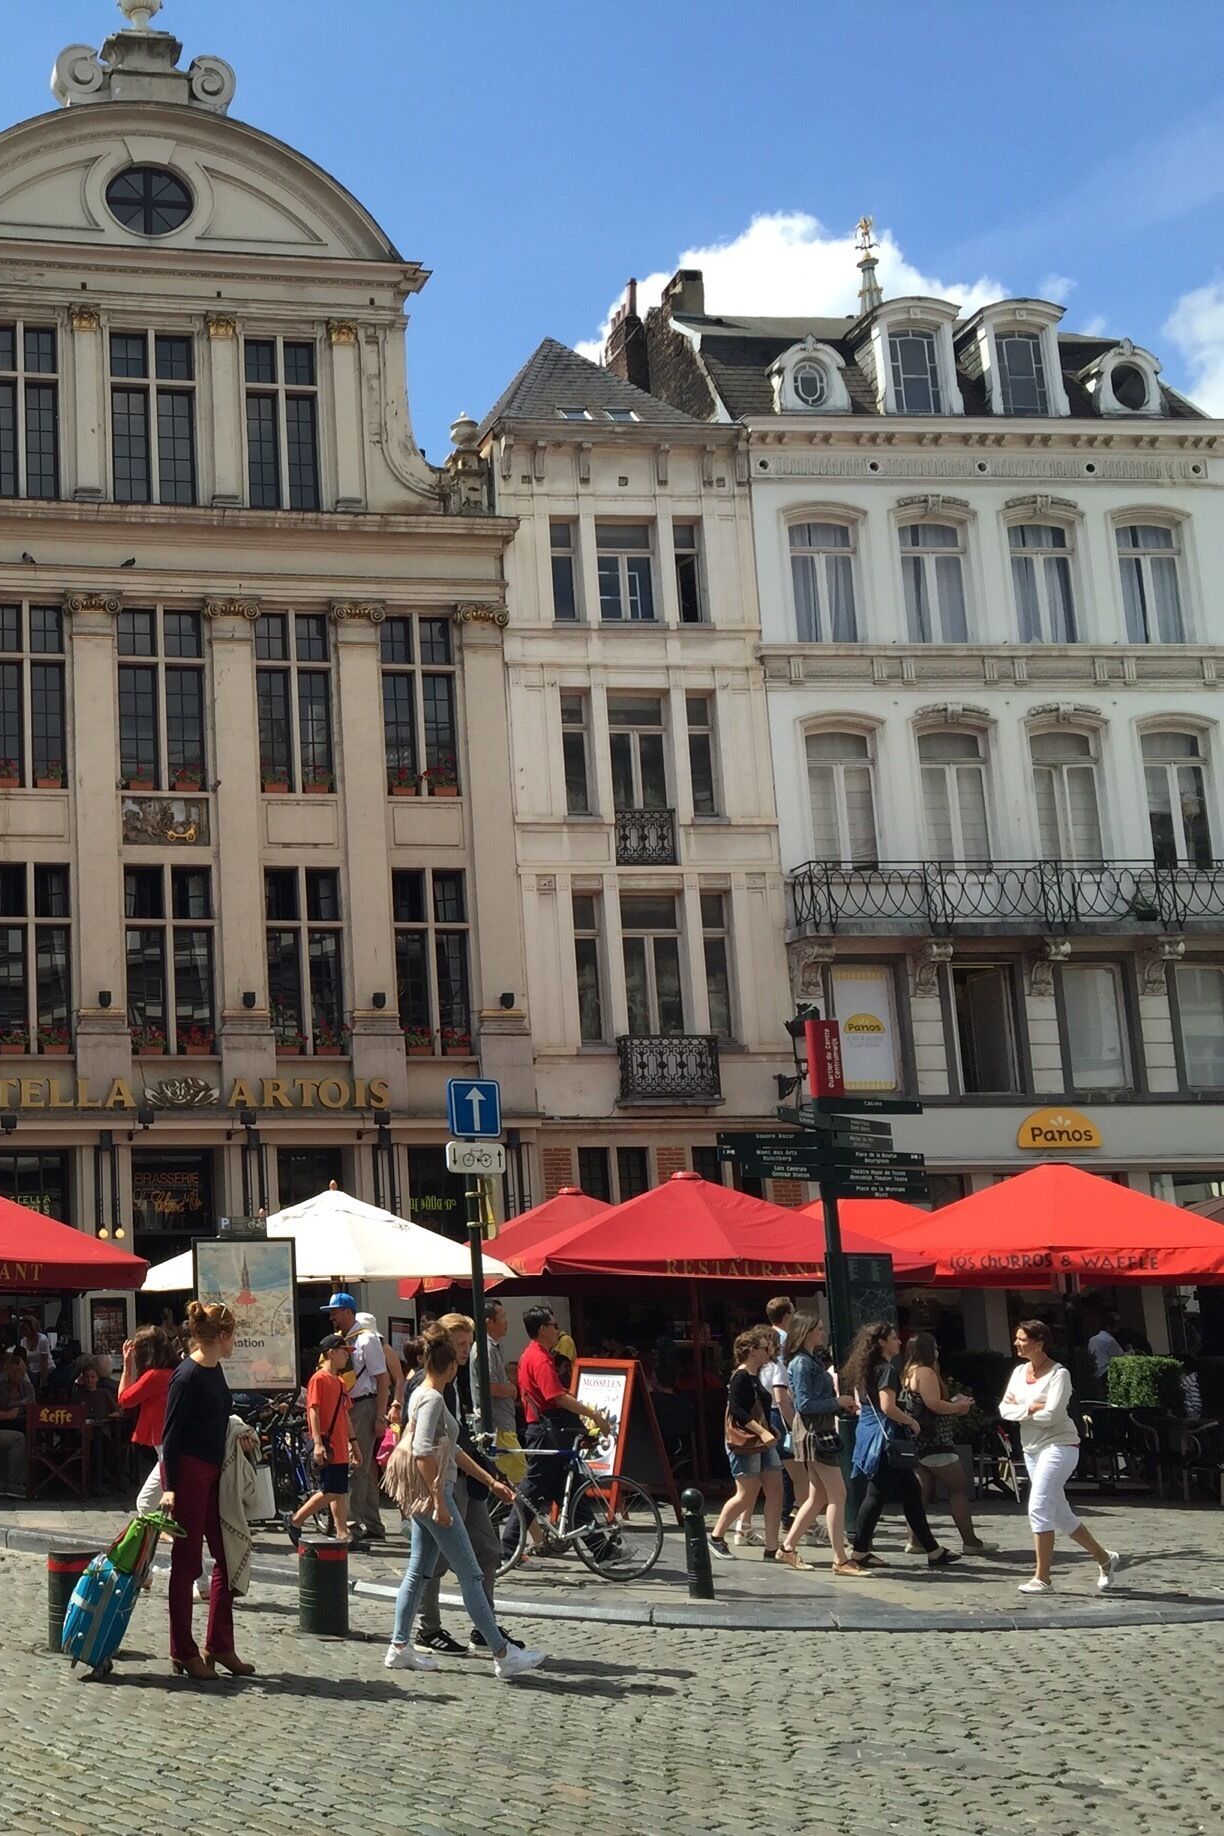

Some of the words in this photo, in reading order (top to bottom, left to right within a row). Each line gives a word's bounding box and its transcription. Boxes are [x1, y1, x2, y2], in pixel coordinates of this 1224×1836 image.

[848, 1023, 882, 1032] Panos
[228, 1077, 392, 1109] ARTOIS
[1030, 1126, 1094, 1143] Panos
[134, 1172, 200, 1184] BRASSERIE
[220, 1217, 230, 1230] P
[666, 1259, 825, 1278] RESTAURANT
[949, 1255, 975, 1270] LOS
[1060, 1255, 1074, 1267] &
[1080, 1254, 1160, 1271] WAFFLE
[39, 1407, 73, 1424] Leffe
